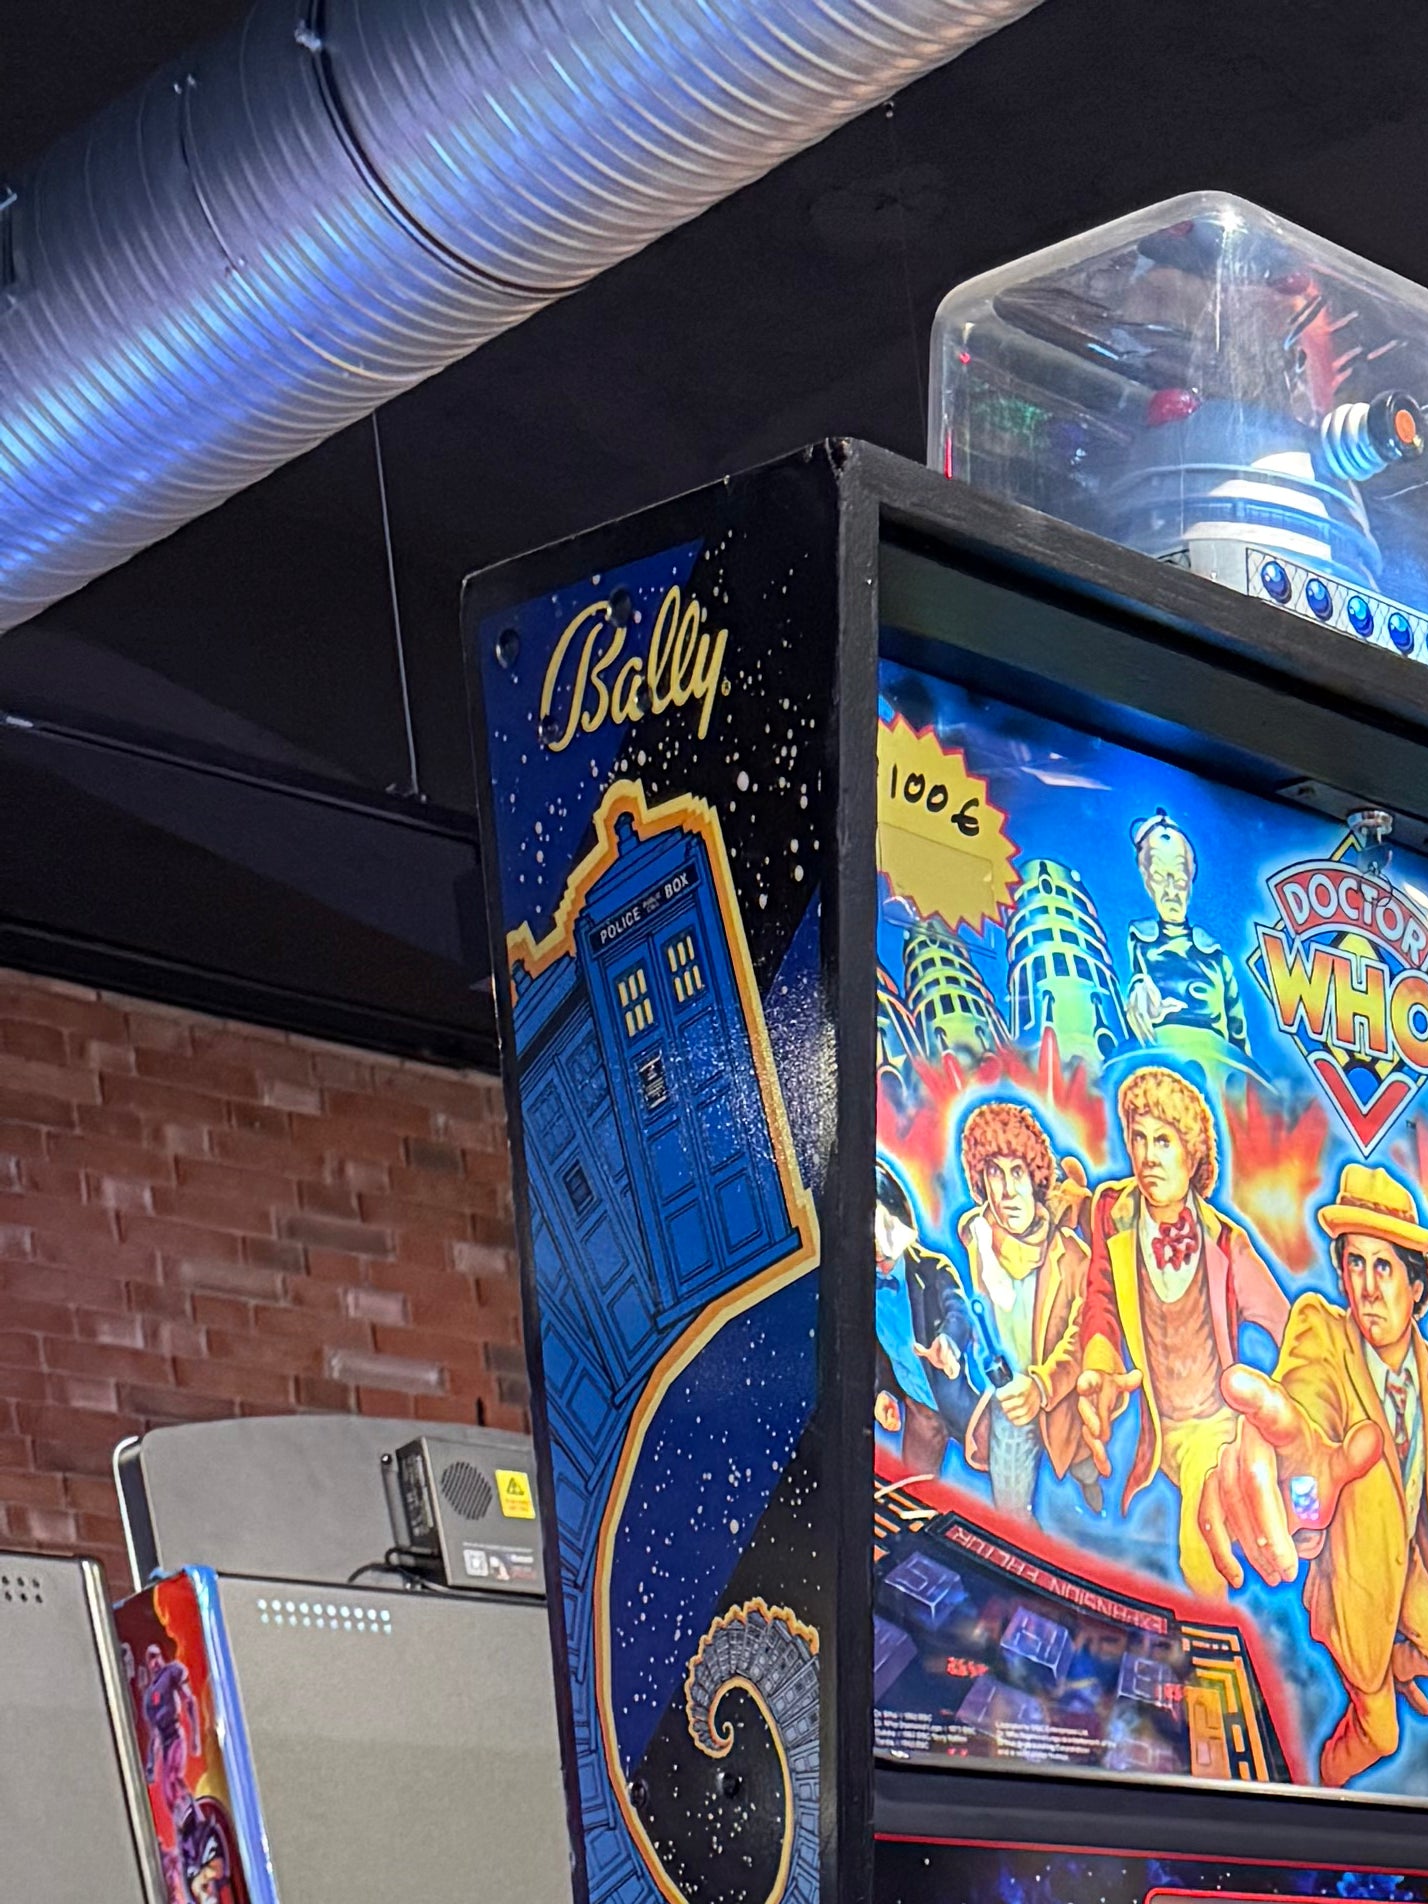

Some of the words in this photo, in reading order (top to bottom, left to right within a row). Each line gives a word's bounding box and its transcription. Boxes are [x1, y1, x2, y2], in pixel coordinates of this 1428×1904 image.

[540, 585, 728, 752] Bally
[890, 763, 980, 836] 100€
[600, 906, 641, 944] POLICE
[664, 872, 690, 899] BOX
[1282, 872, 1428, 961] DOCTOR
